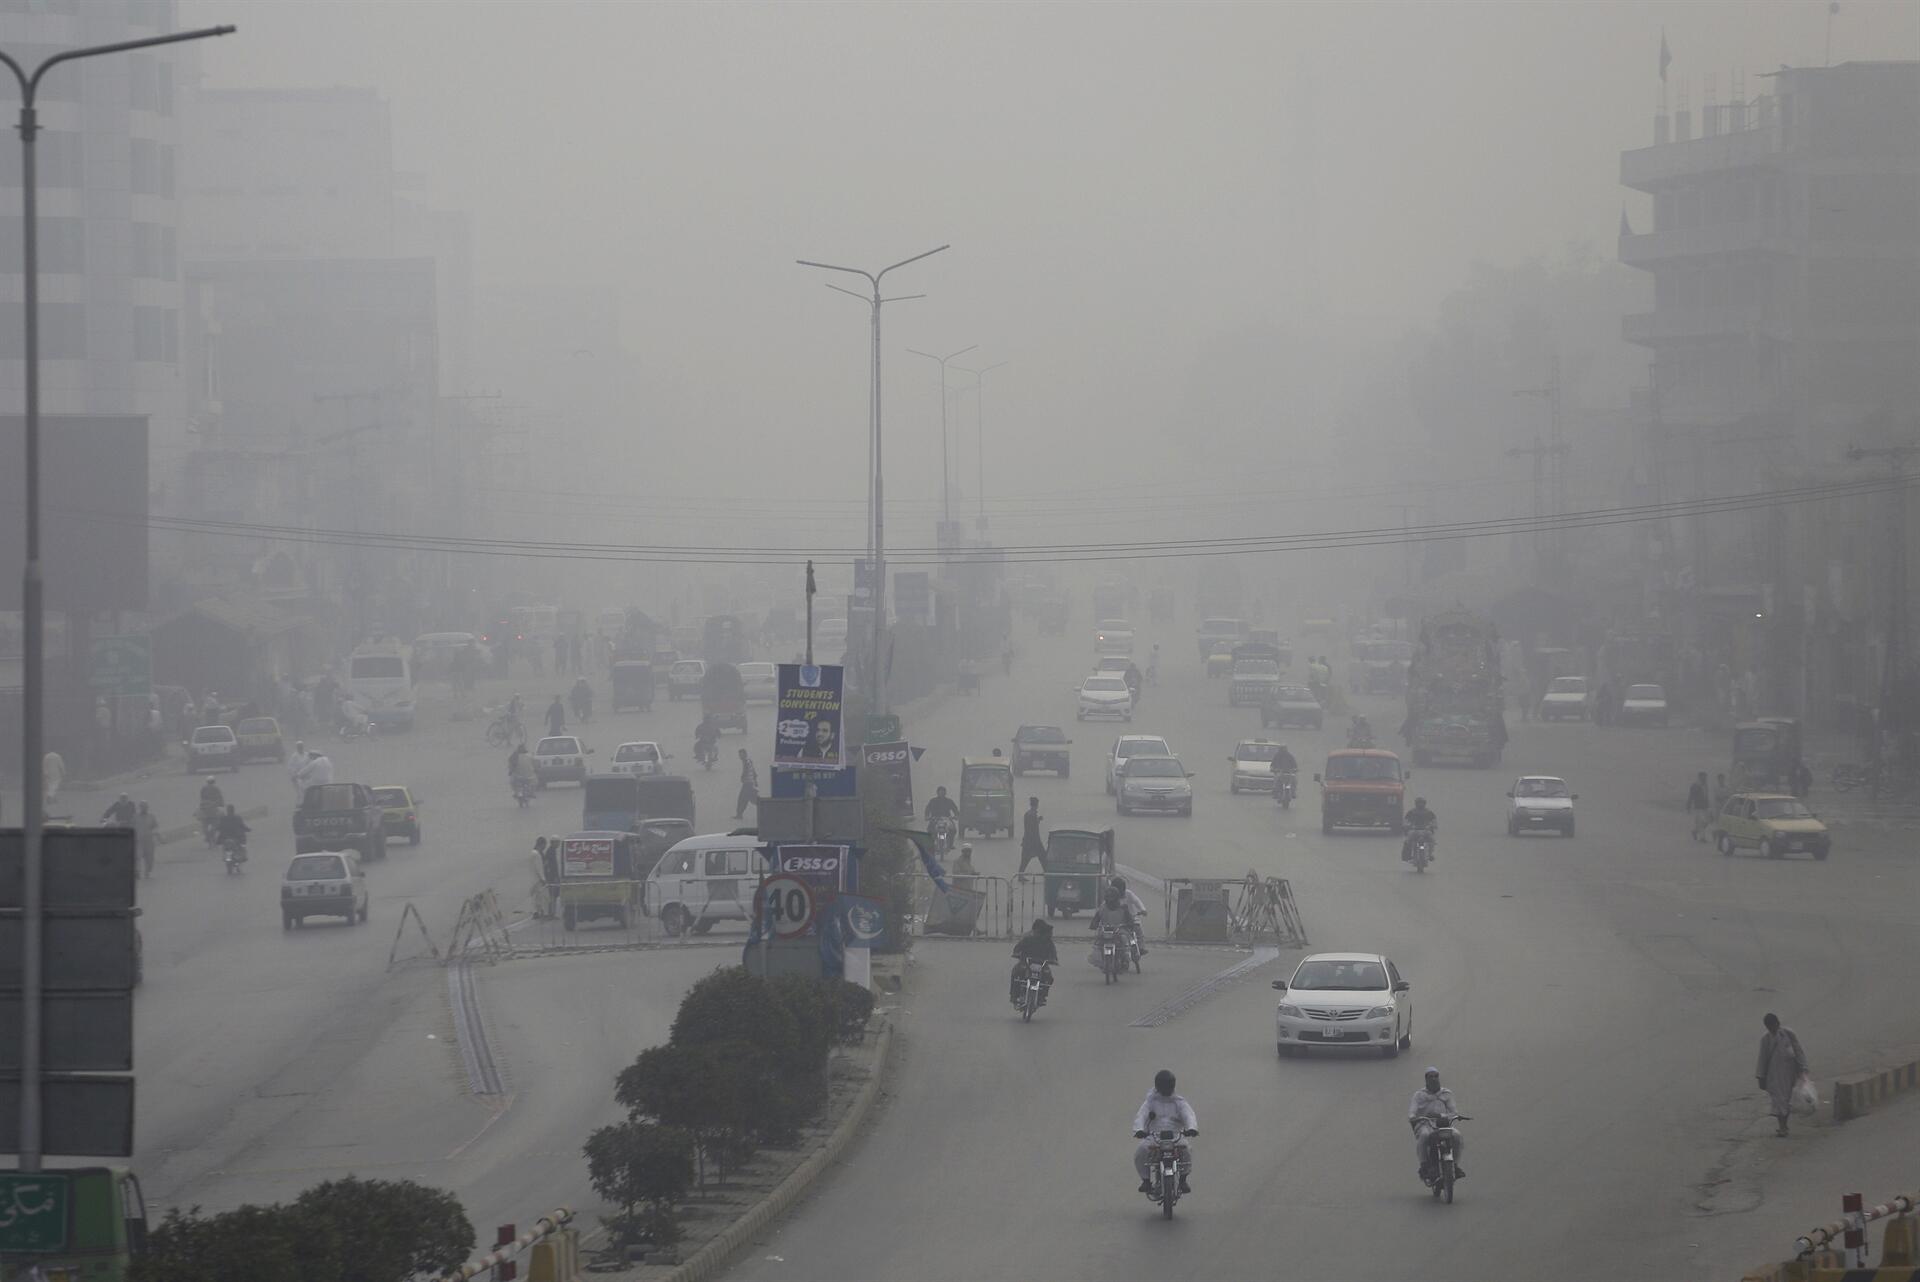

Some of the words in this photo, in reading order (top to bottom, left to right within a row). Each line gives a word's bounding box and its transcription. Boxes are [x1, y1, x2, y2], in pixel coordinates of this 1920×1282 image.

[786, 689, 834, 700] STUDENTS
[780, 700, 841, 711] CONVENTION
[305, 817, 353, 826] TOYOTA
[768, 888, 806, 922] 40
